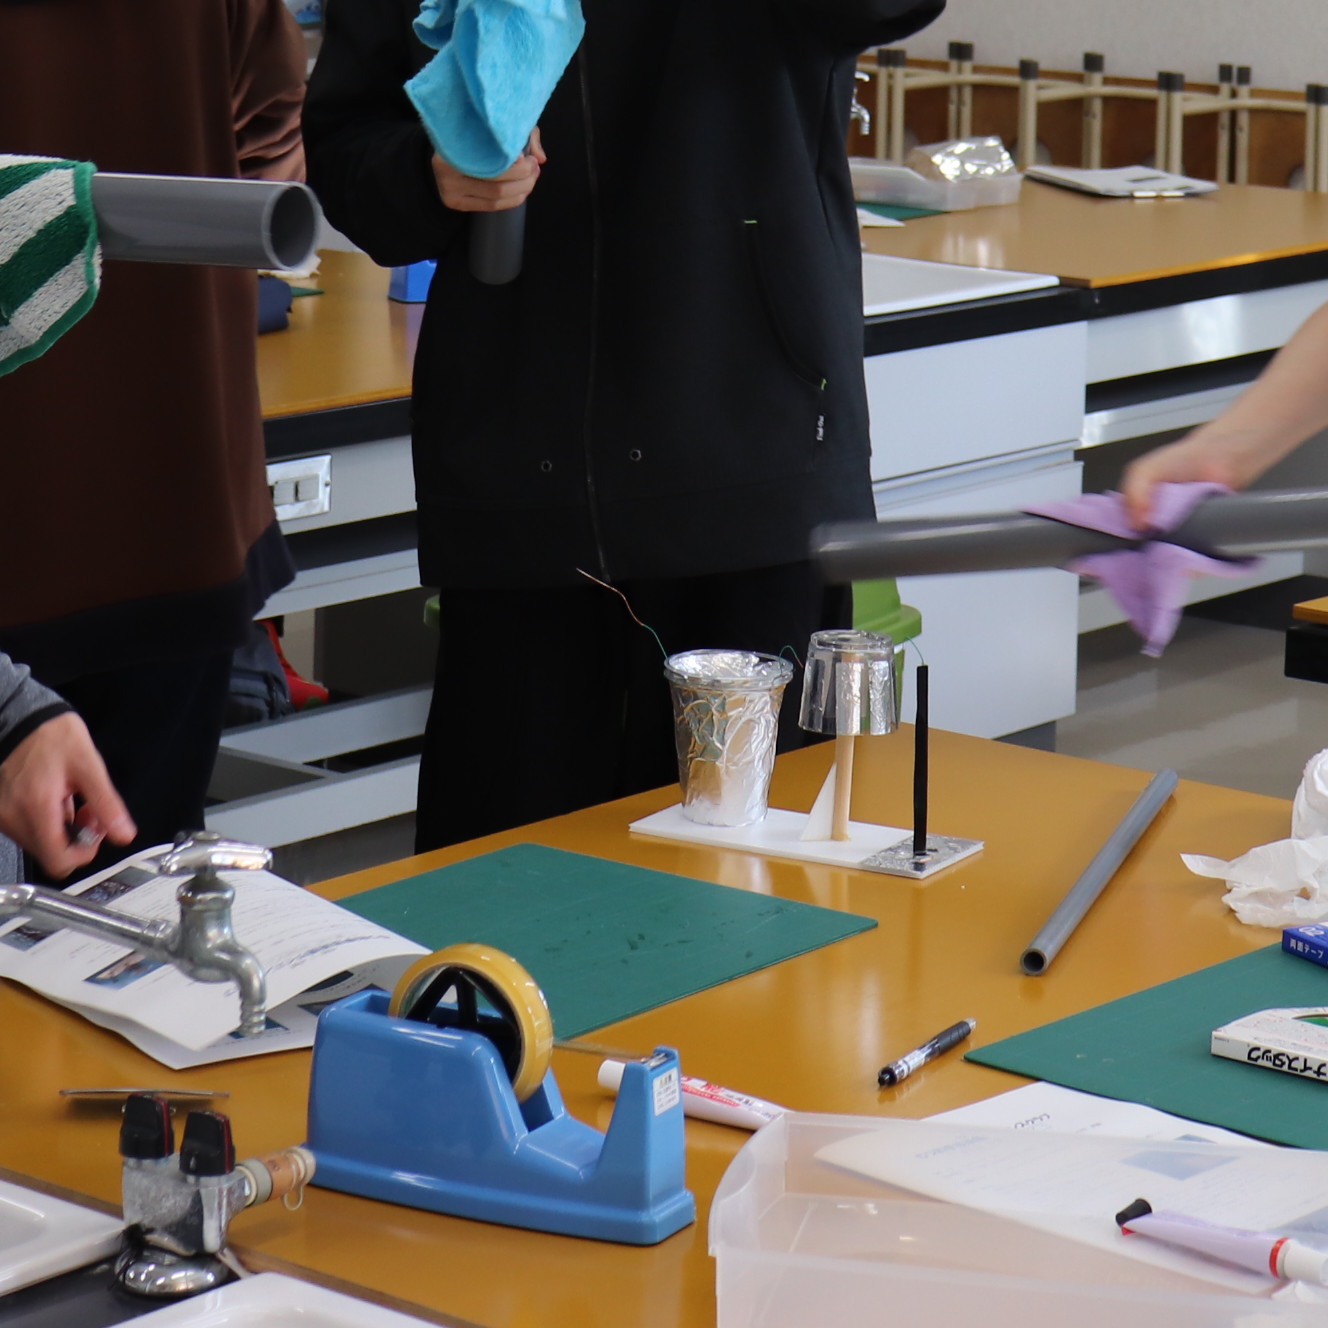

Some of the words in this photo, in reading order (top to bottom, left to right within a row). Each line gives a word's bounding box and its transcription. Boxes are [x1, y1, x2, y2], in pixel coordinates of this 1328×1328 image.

[1247, 1046, 1327, 1077] ナイスタック
